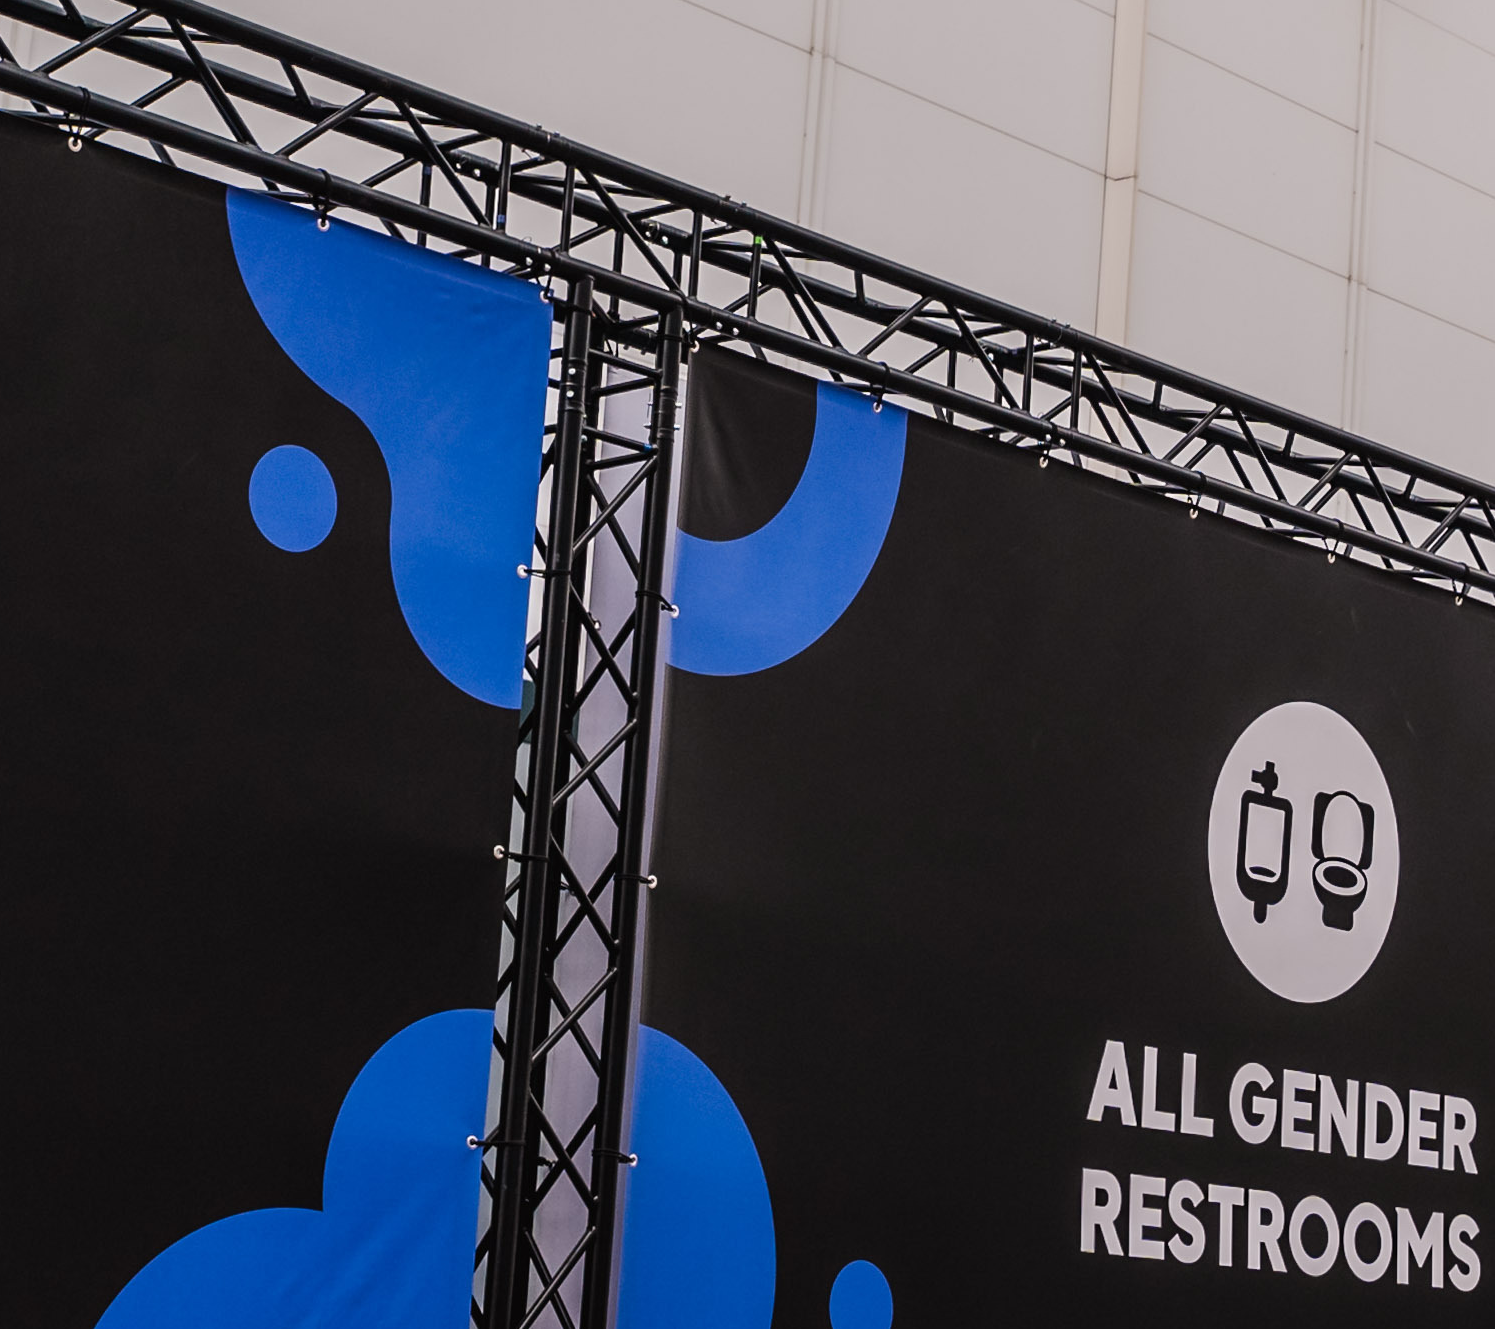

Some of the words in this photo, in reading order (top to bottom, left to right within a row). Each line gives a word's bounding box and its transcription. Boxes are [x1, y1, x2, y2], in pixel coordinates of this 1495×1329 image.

[1087, 1040, 1214, 1137] ALL
[1229, 1063, 1478, 1174] GENDER
[1081, 1168, 1481, 1291] RESTROOMS
